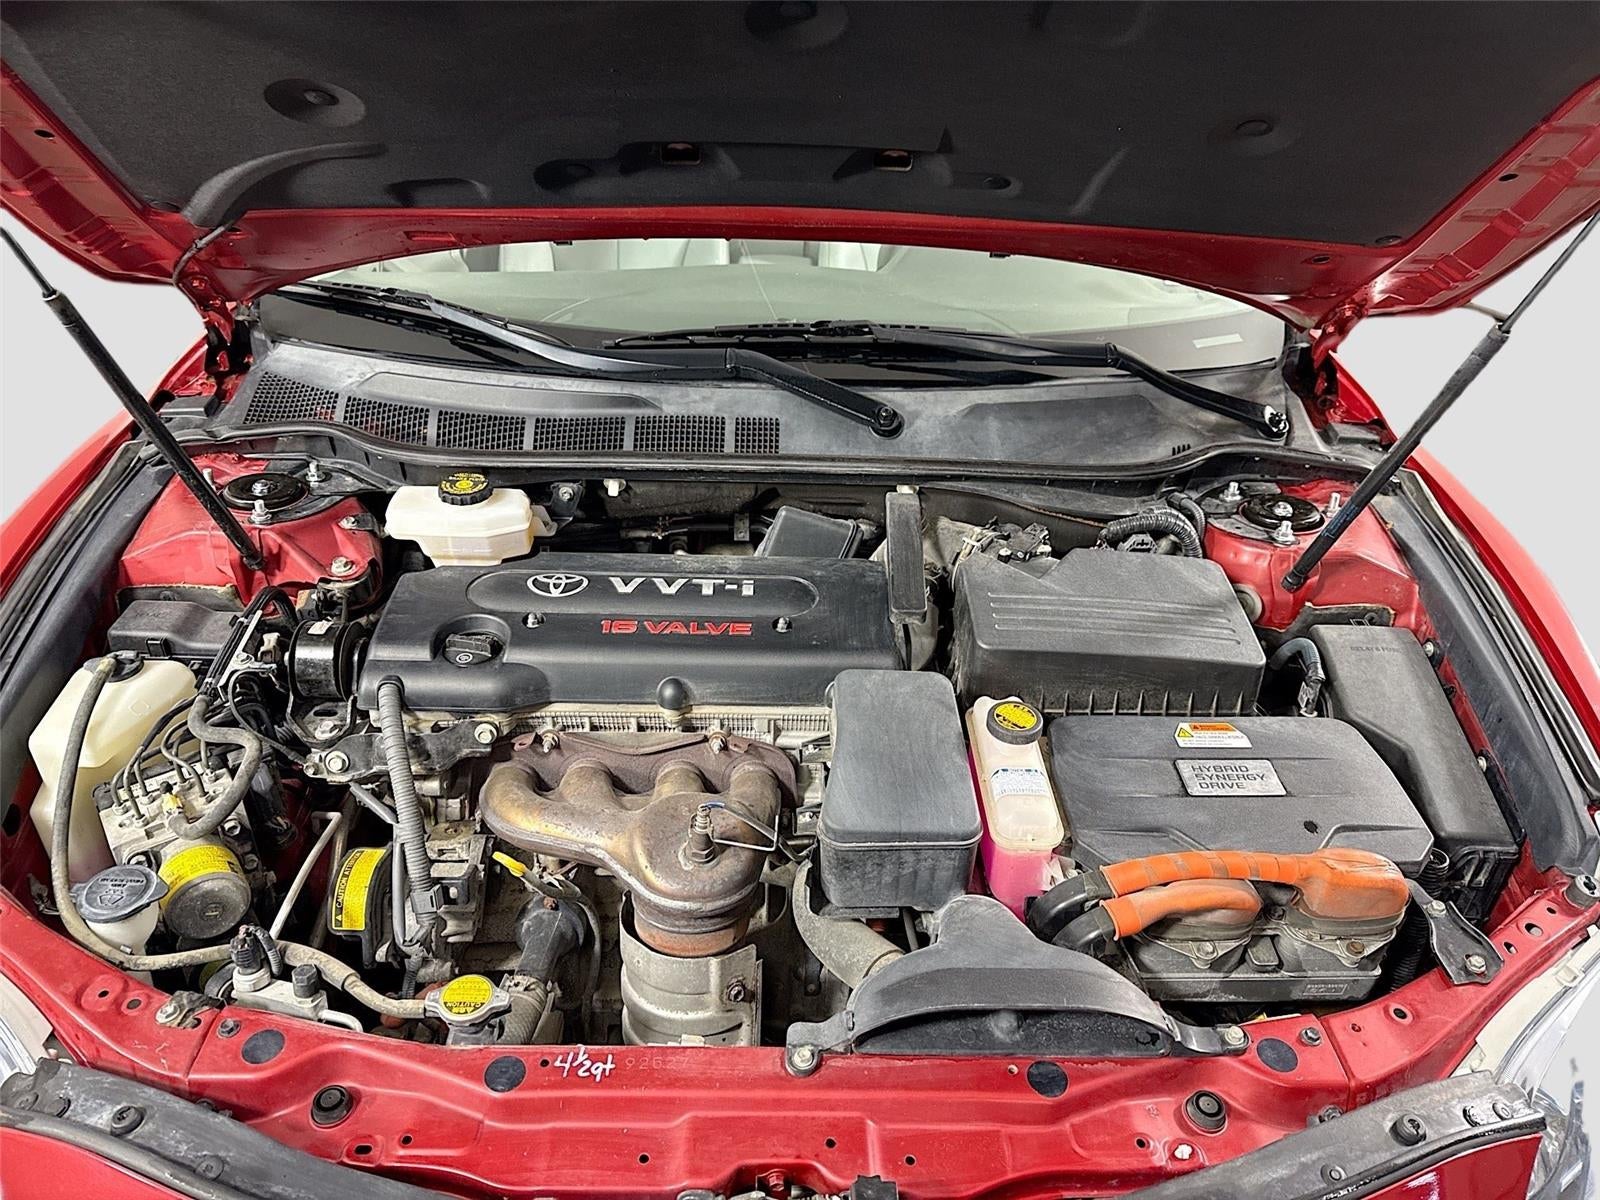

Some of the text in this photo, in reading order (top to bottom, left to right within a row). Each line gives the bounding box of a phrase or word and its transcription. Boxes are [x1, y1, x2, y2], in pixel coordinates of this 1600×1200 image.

[609, 576, 755, 596] VVT-i
[600, 619, 753, 636] 16 VALVE
[1191, 765, 1249, 773] HYBRID
[1195, 773, 1266, 781] SYNERGY
[336, 876, 348, 908] CAUTION
